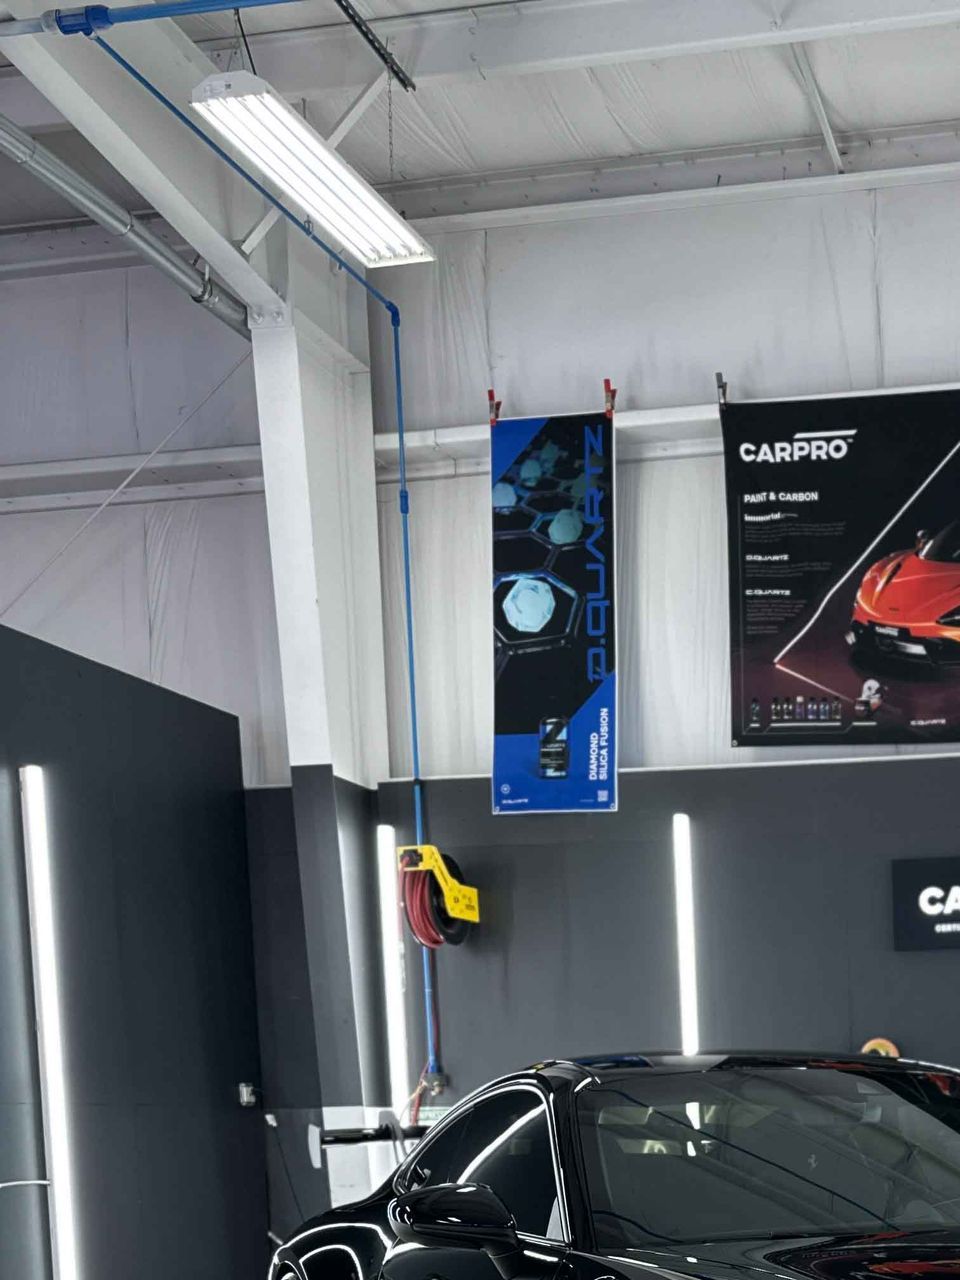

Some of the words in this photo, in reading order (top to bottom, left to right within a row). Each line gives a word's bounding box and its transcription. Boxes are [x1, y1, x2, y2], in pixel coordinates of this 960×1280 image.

[739, 438, 849, 463] CARPRO
[743, 493, 767, 503] PAINT
[768, 492, 777, 501] &
[778, 491, 819, 502] CARBON
[599, 707, 609, 746] FUSION
[588, 732, 598, 781] DIAMOND
[599, 748, 609, 781] SILICA
